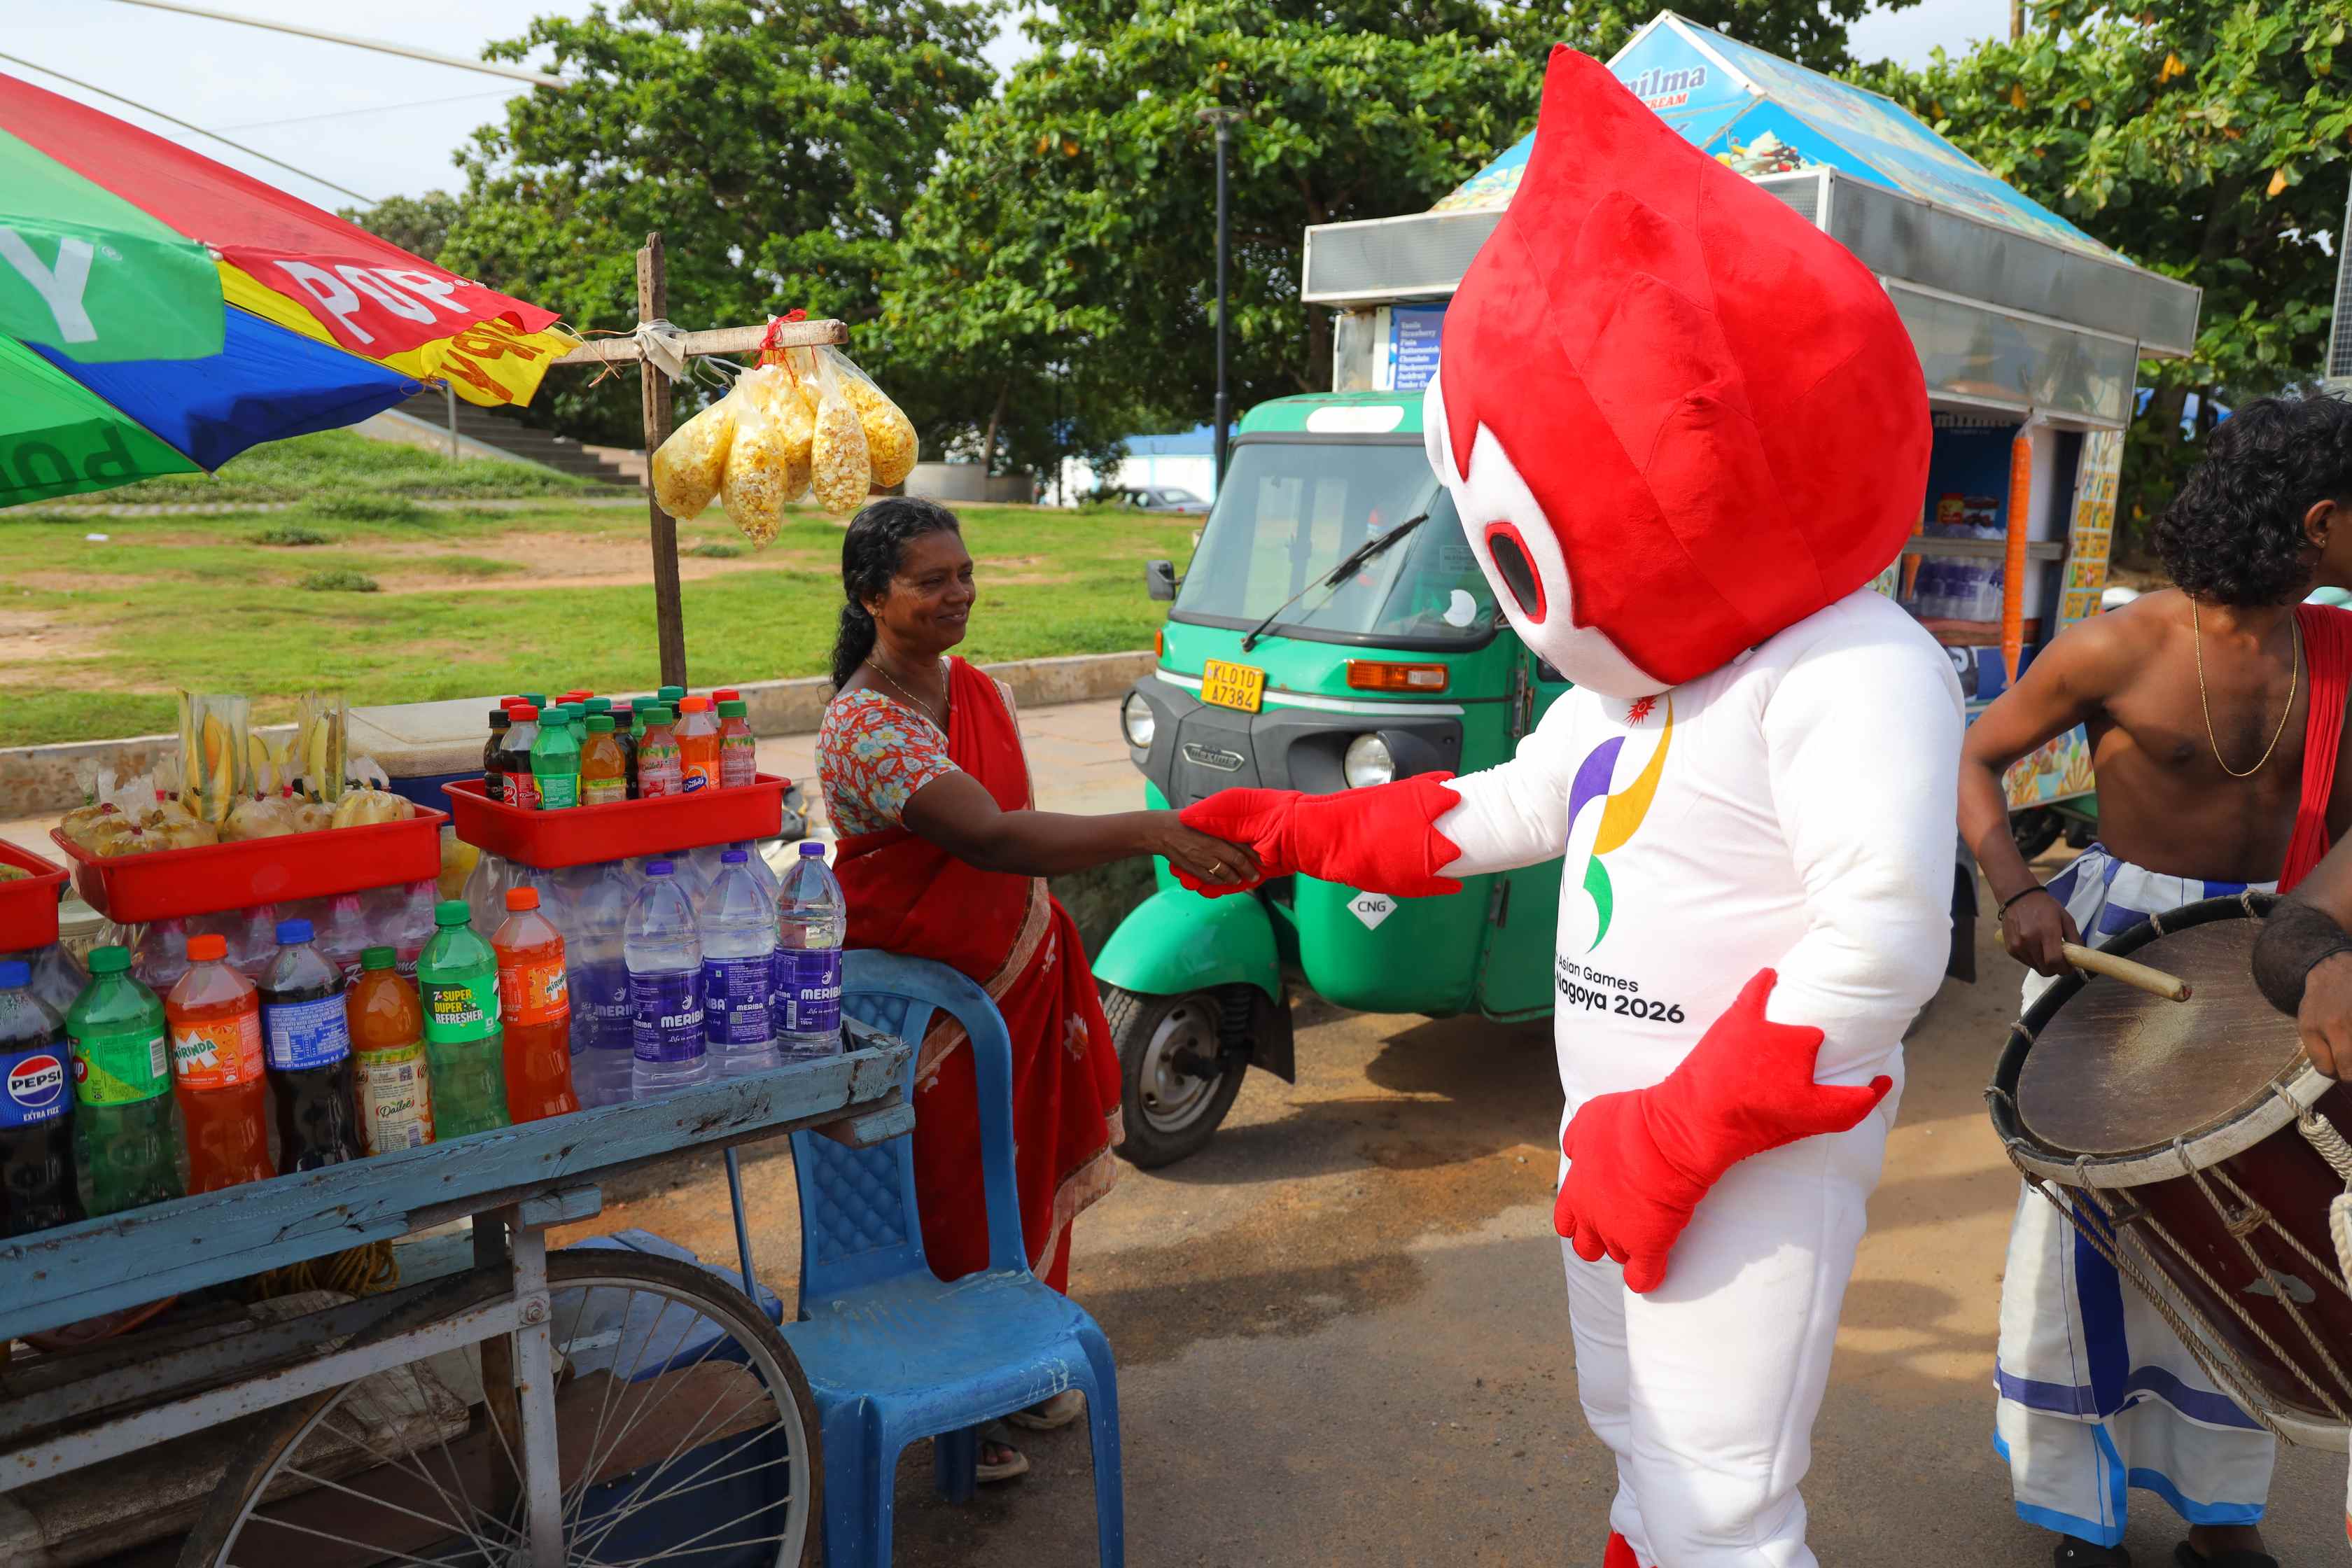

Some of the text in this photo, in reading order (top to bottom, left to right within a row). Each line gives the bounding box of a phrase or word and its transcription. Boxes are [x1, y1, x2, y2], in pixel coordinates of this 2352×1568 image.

[1213, 664, 1256, 688] KL01D
[1212, 685, 1254, 708] A7384
[1357, 901, 1387, 912] CNG
[1558, 954, 1581, 977] Asian
[1583, 966, 1639, 993] Games
[442, 988, 472, 1002] SUPER
[434, 1002, 463, 1013] DUPER
[736, 1002, 764, 1011] MERIBA
[1614, 995, 1686, 1024] 2026
[435, 1009, 483, 1024] REFRESHER
[660, 1007, 704, 1028] MERIBA
[11, 1070, 61, 1091] PEPSI
[23, 1106, 60, 1121] EXTRA FIZZ
